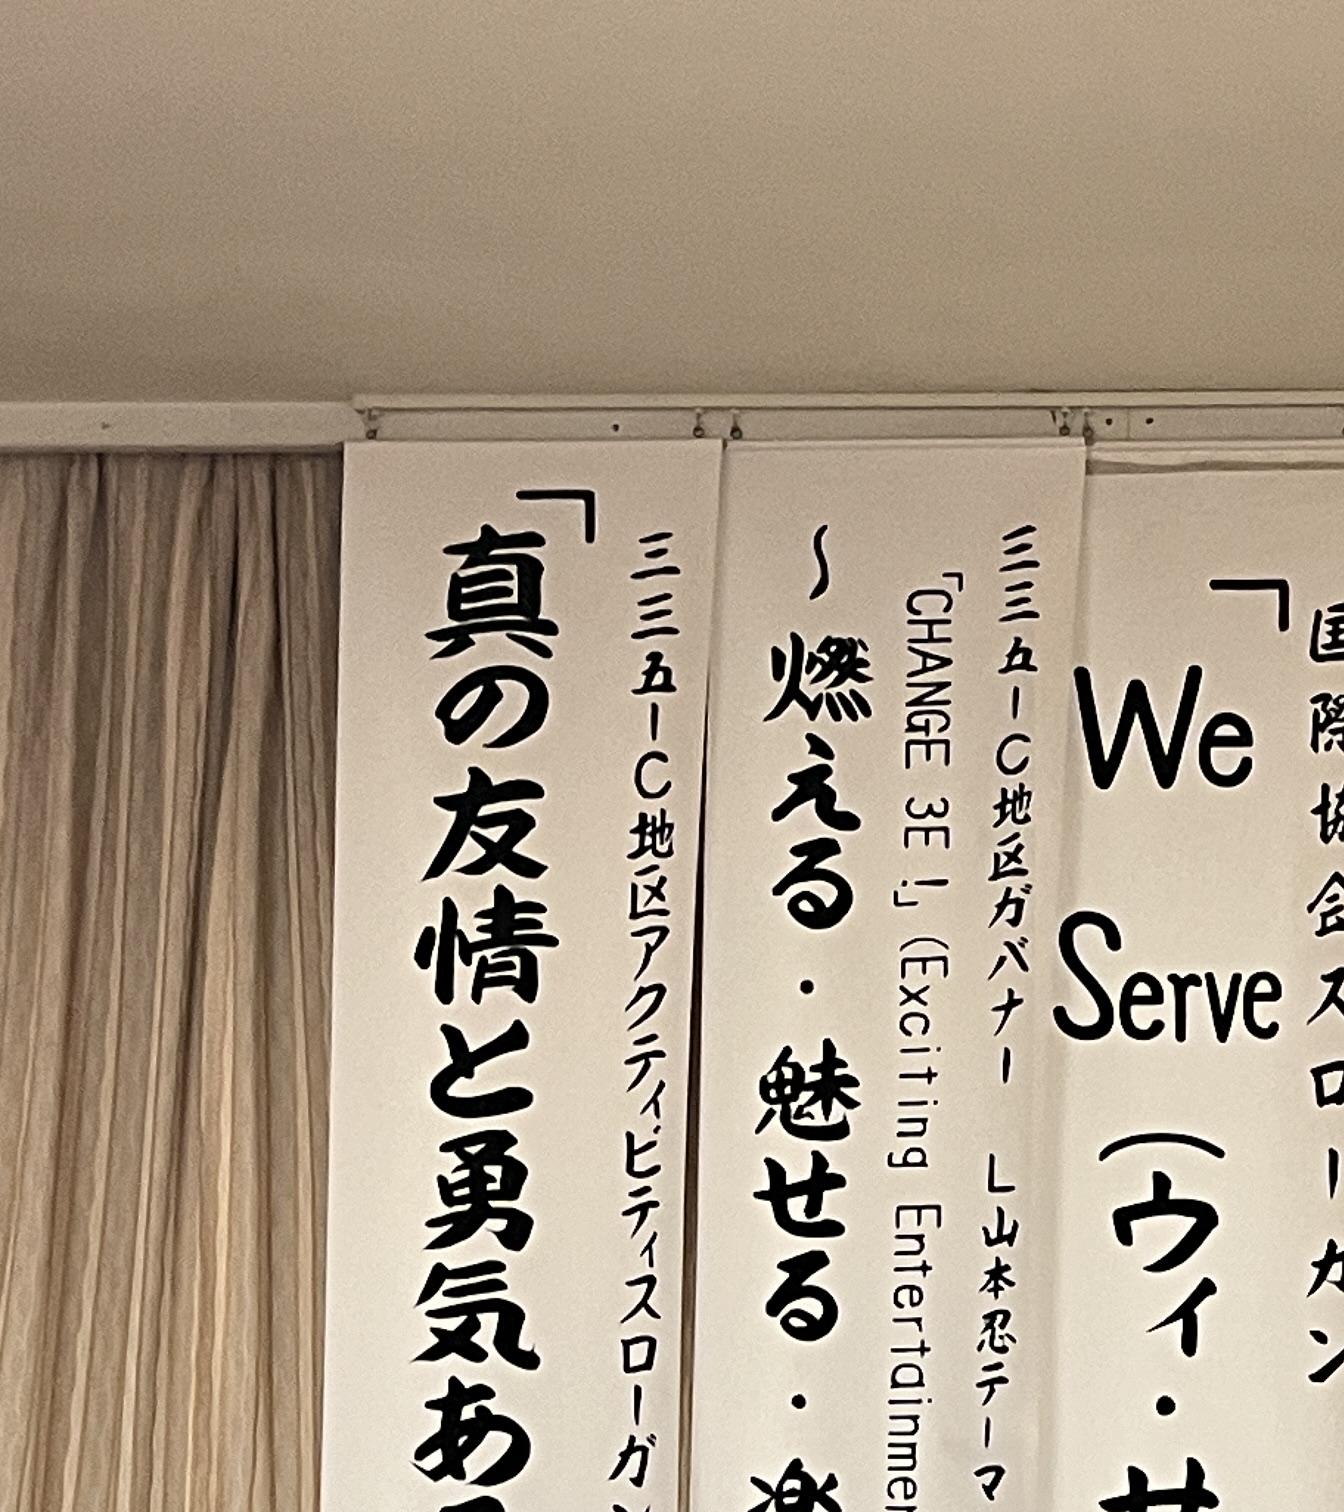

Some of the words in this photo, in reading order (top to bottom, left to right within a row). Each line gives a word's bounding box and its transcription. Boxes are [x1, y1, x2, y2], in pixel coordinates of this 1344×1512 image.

[1051, 910, 1283, 1044] Serve
[973, 1151, 1020, 1503] L山本忍テーマ
